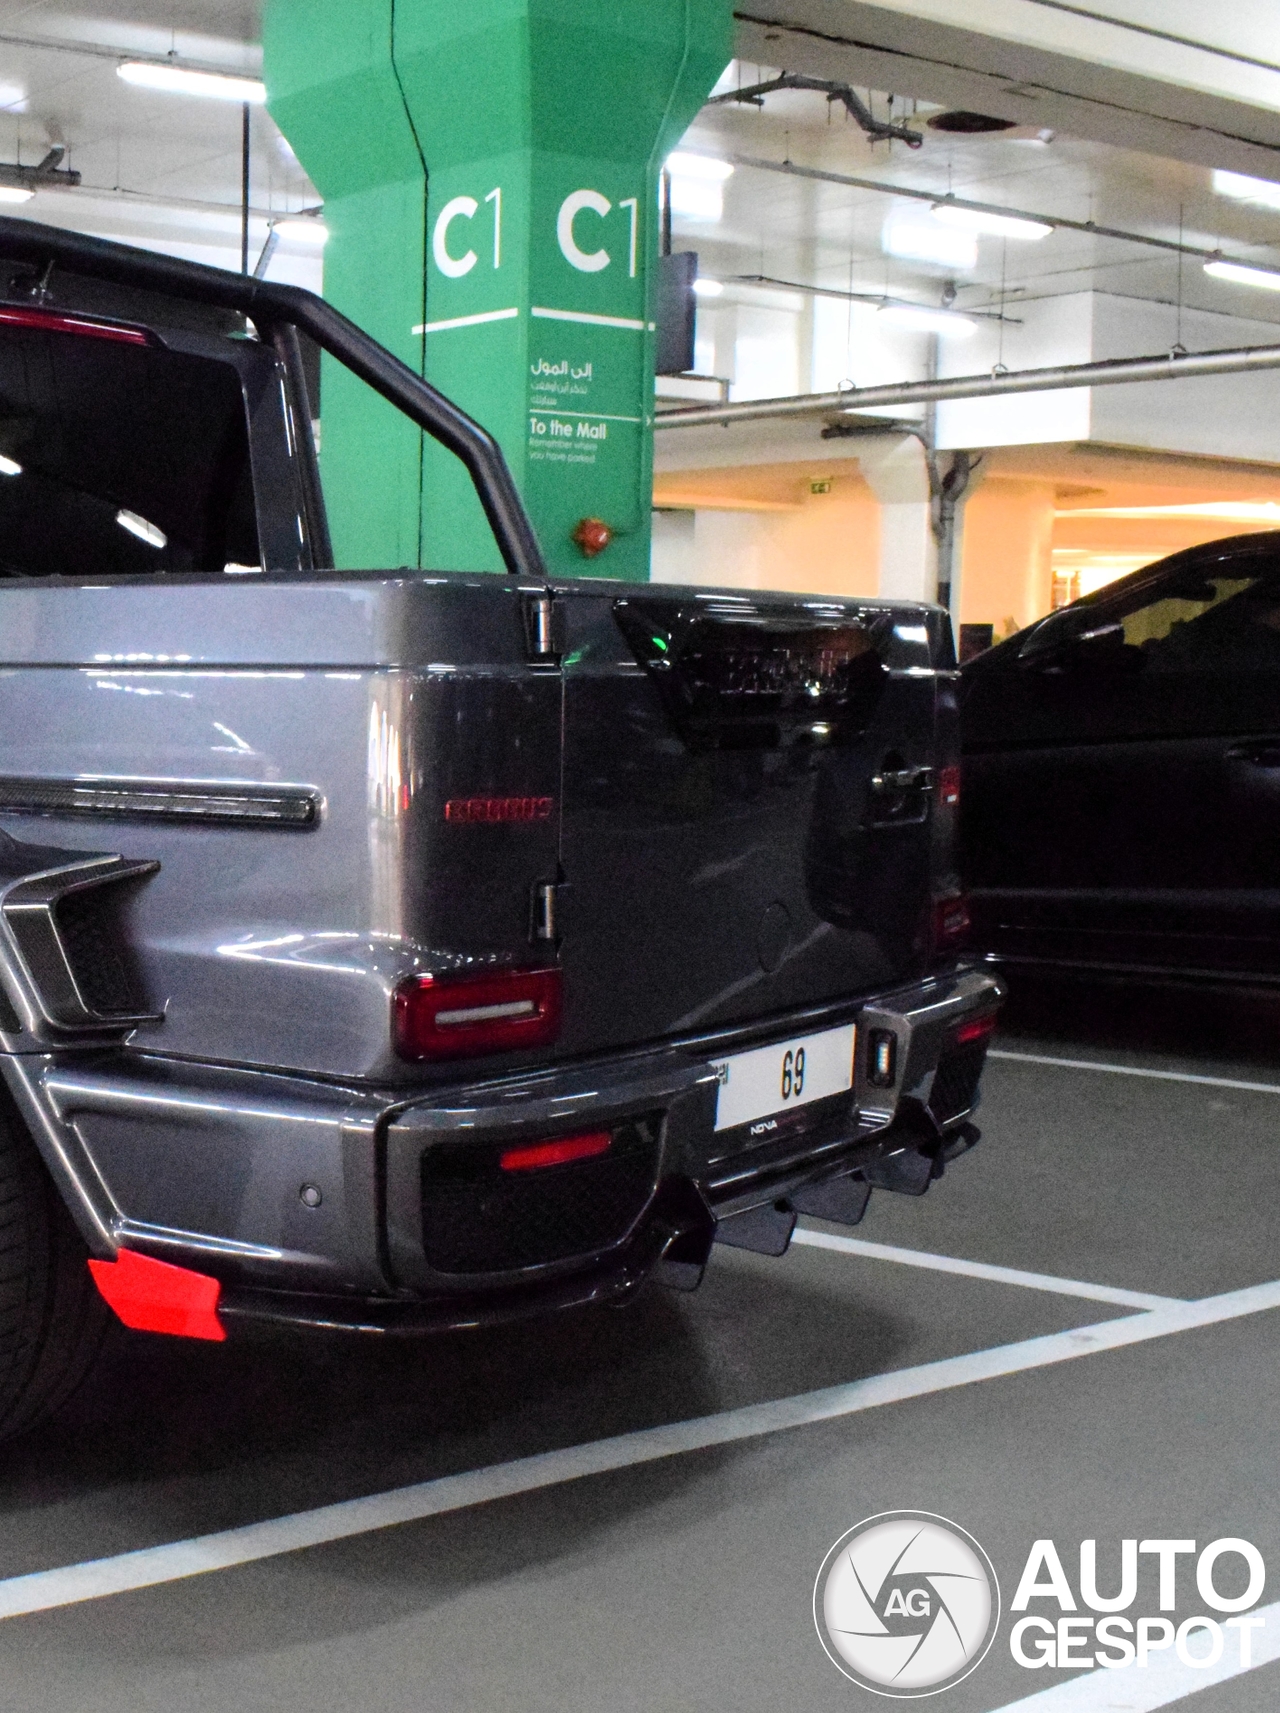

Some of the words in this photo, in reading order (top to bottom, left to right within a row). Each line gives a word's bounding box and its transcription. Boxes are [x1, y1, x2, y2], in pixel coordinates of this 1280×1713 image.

[433, 187, 501, 278] C1
[557, 189, 637, 278] C1
[531, 358, 568, 376] المول
[570, 362, 592, 381] إلى
[530, 417, 546, 434] To
[550, 419, 573, 437] the
[576, 422, 607, 440] Mall
[781, 1047, 805, 1100] 69
[750, 1119, 778, 1136] NOVA
